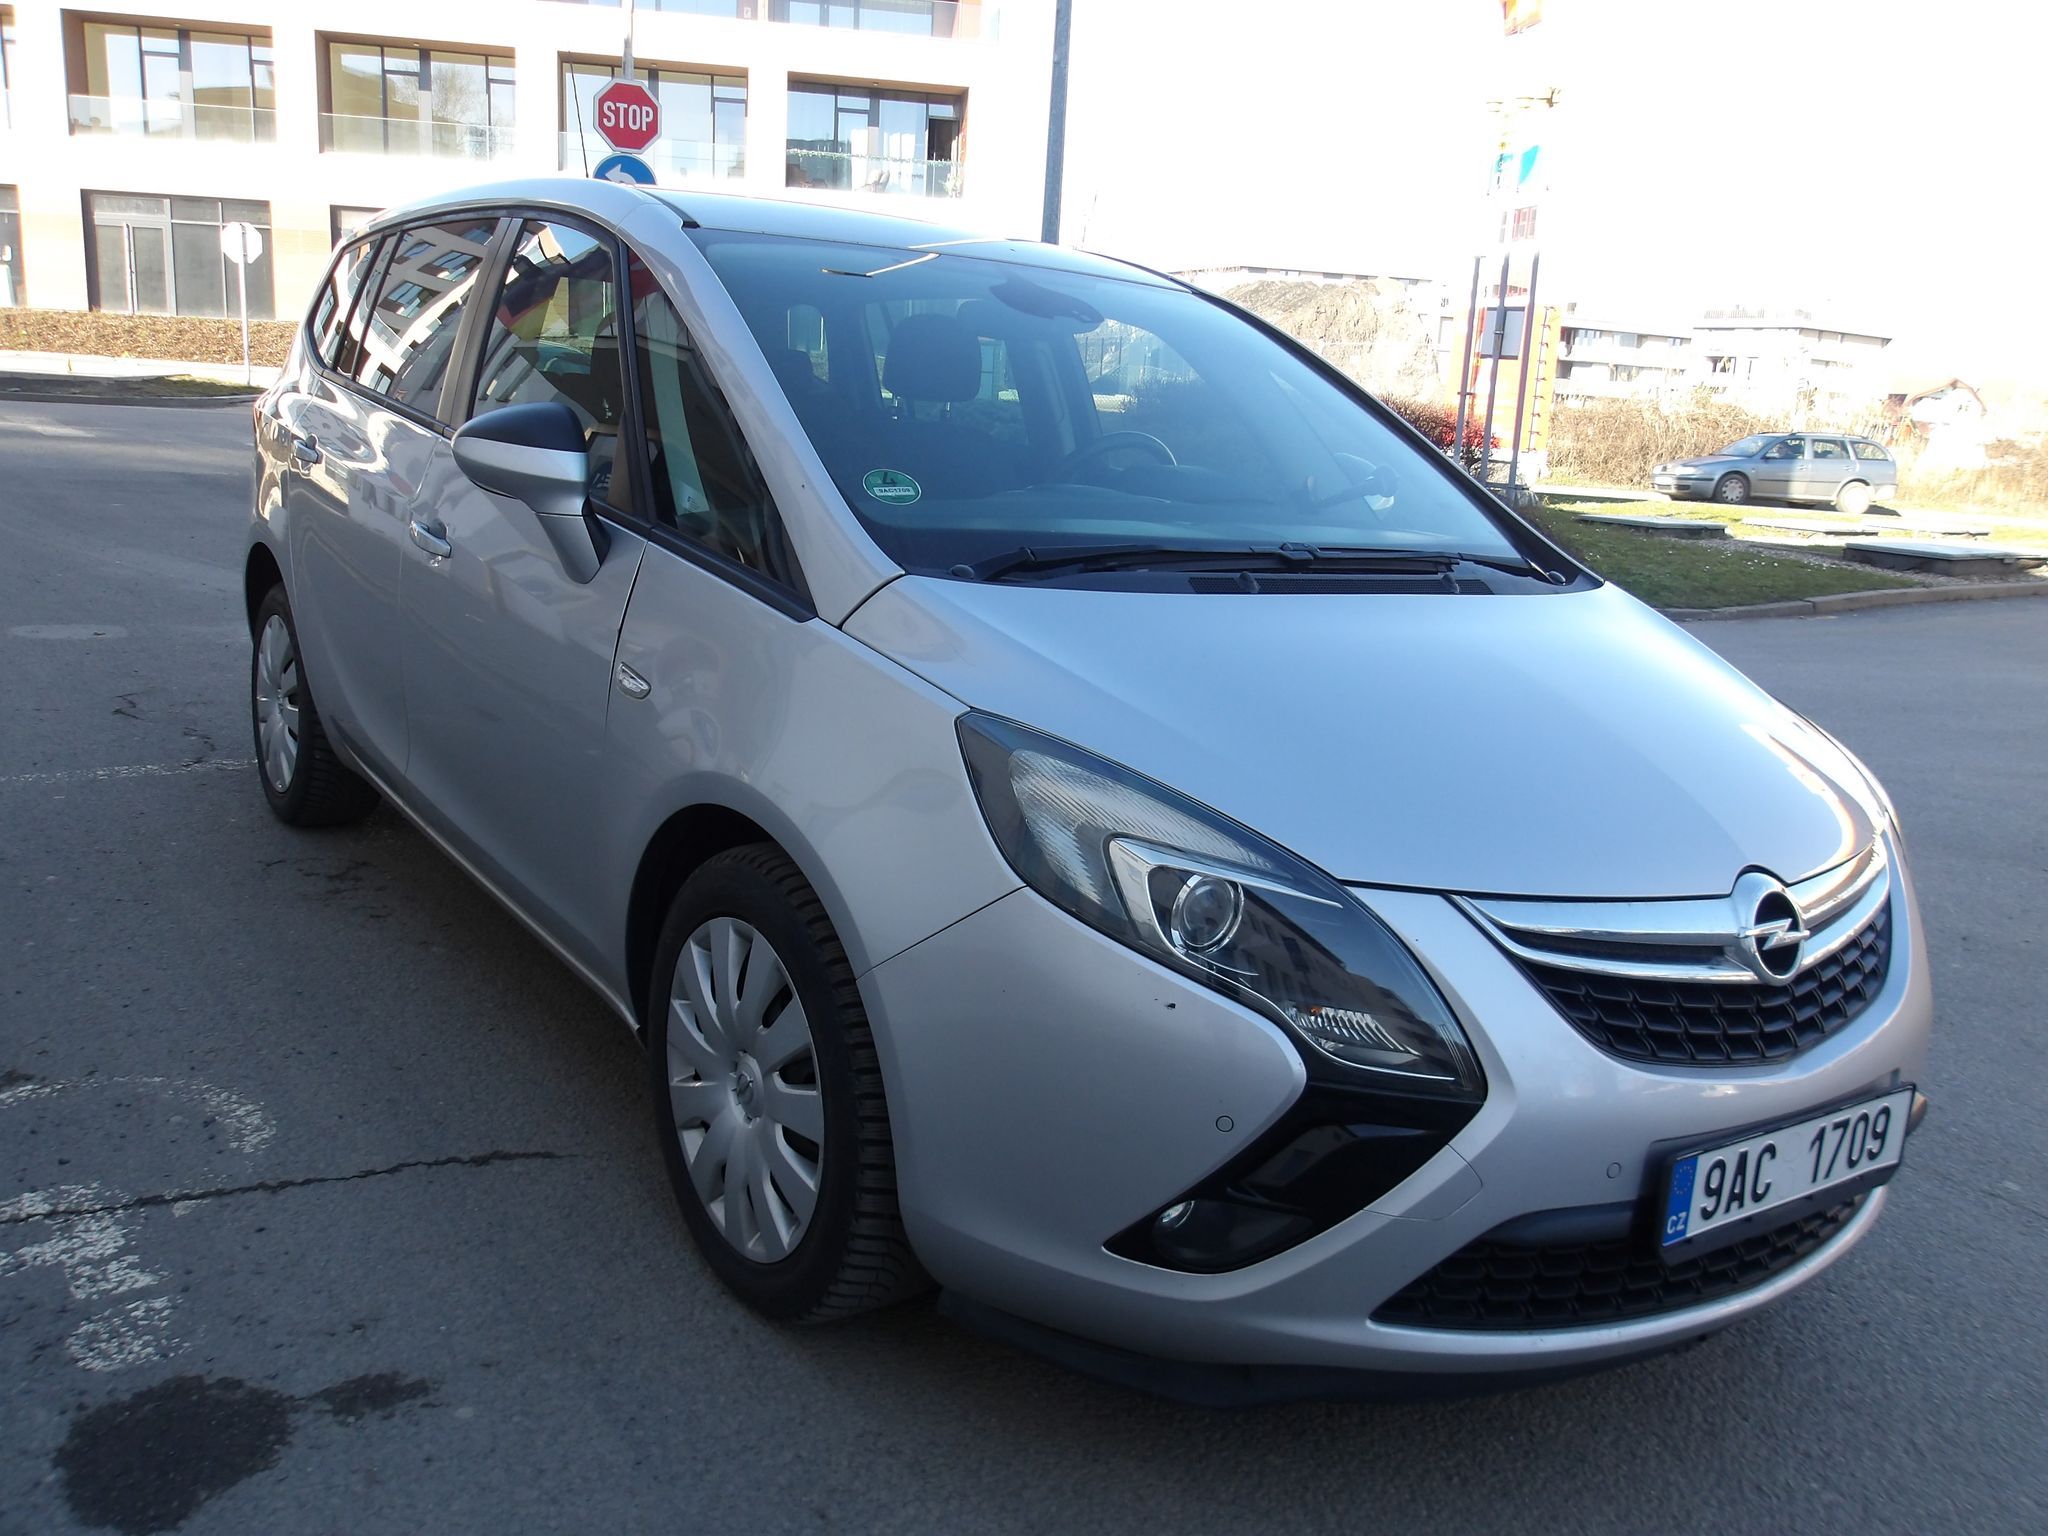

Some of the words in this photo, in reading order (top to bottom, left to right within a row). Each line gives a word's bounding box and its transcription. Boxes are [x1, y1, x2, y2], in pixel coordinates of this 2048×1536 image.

[603, 101, 654, 131] STOP
[1701, 1141, 1776, 1220] 9AC
[1809, 1103, 1891, 1183] 1709
[1666, 1211, 1687, 1234] CZ
